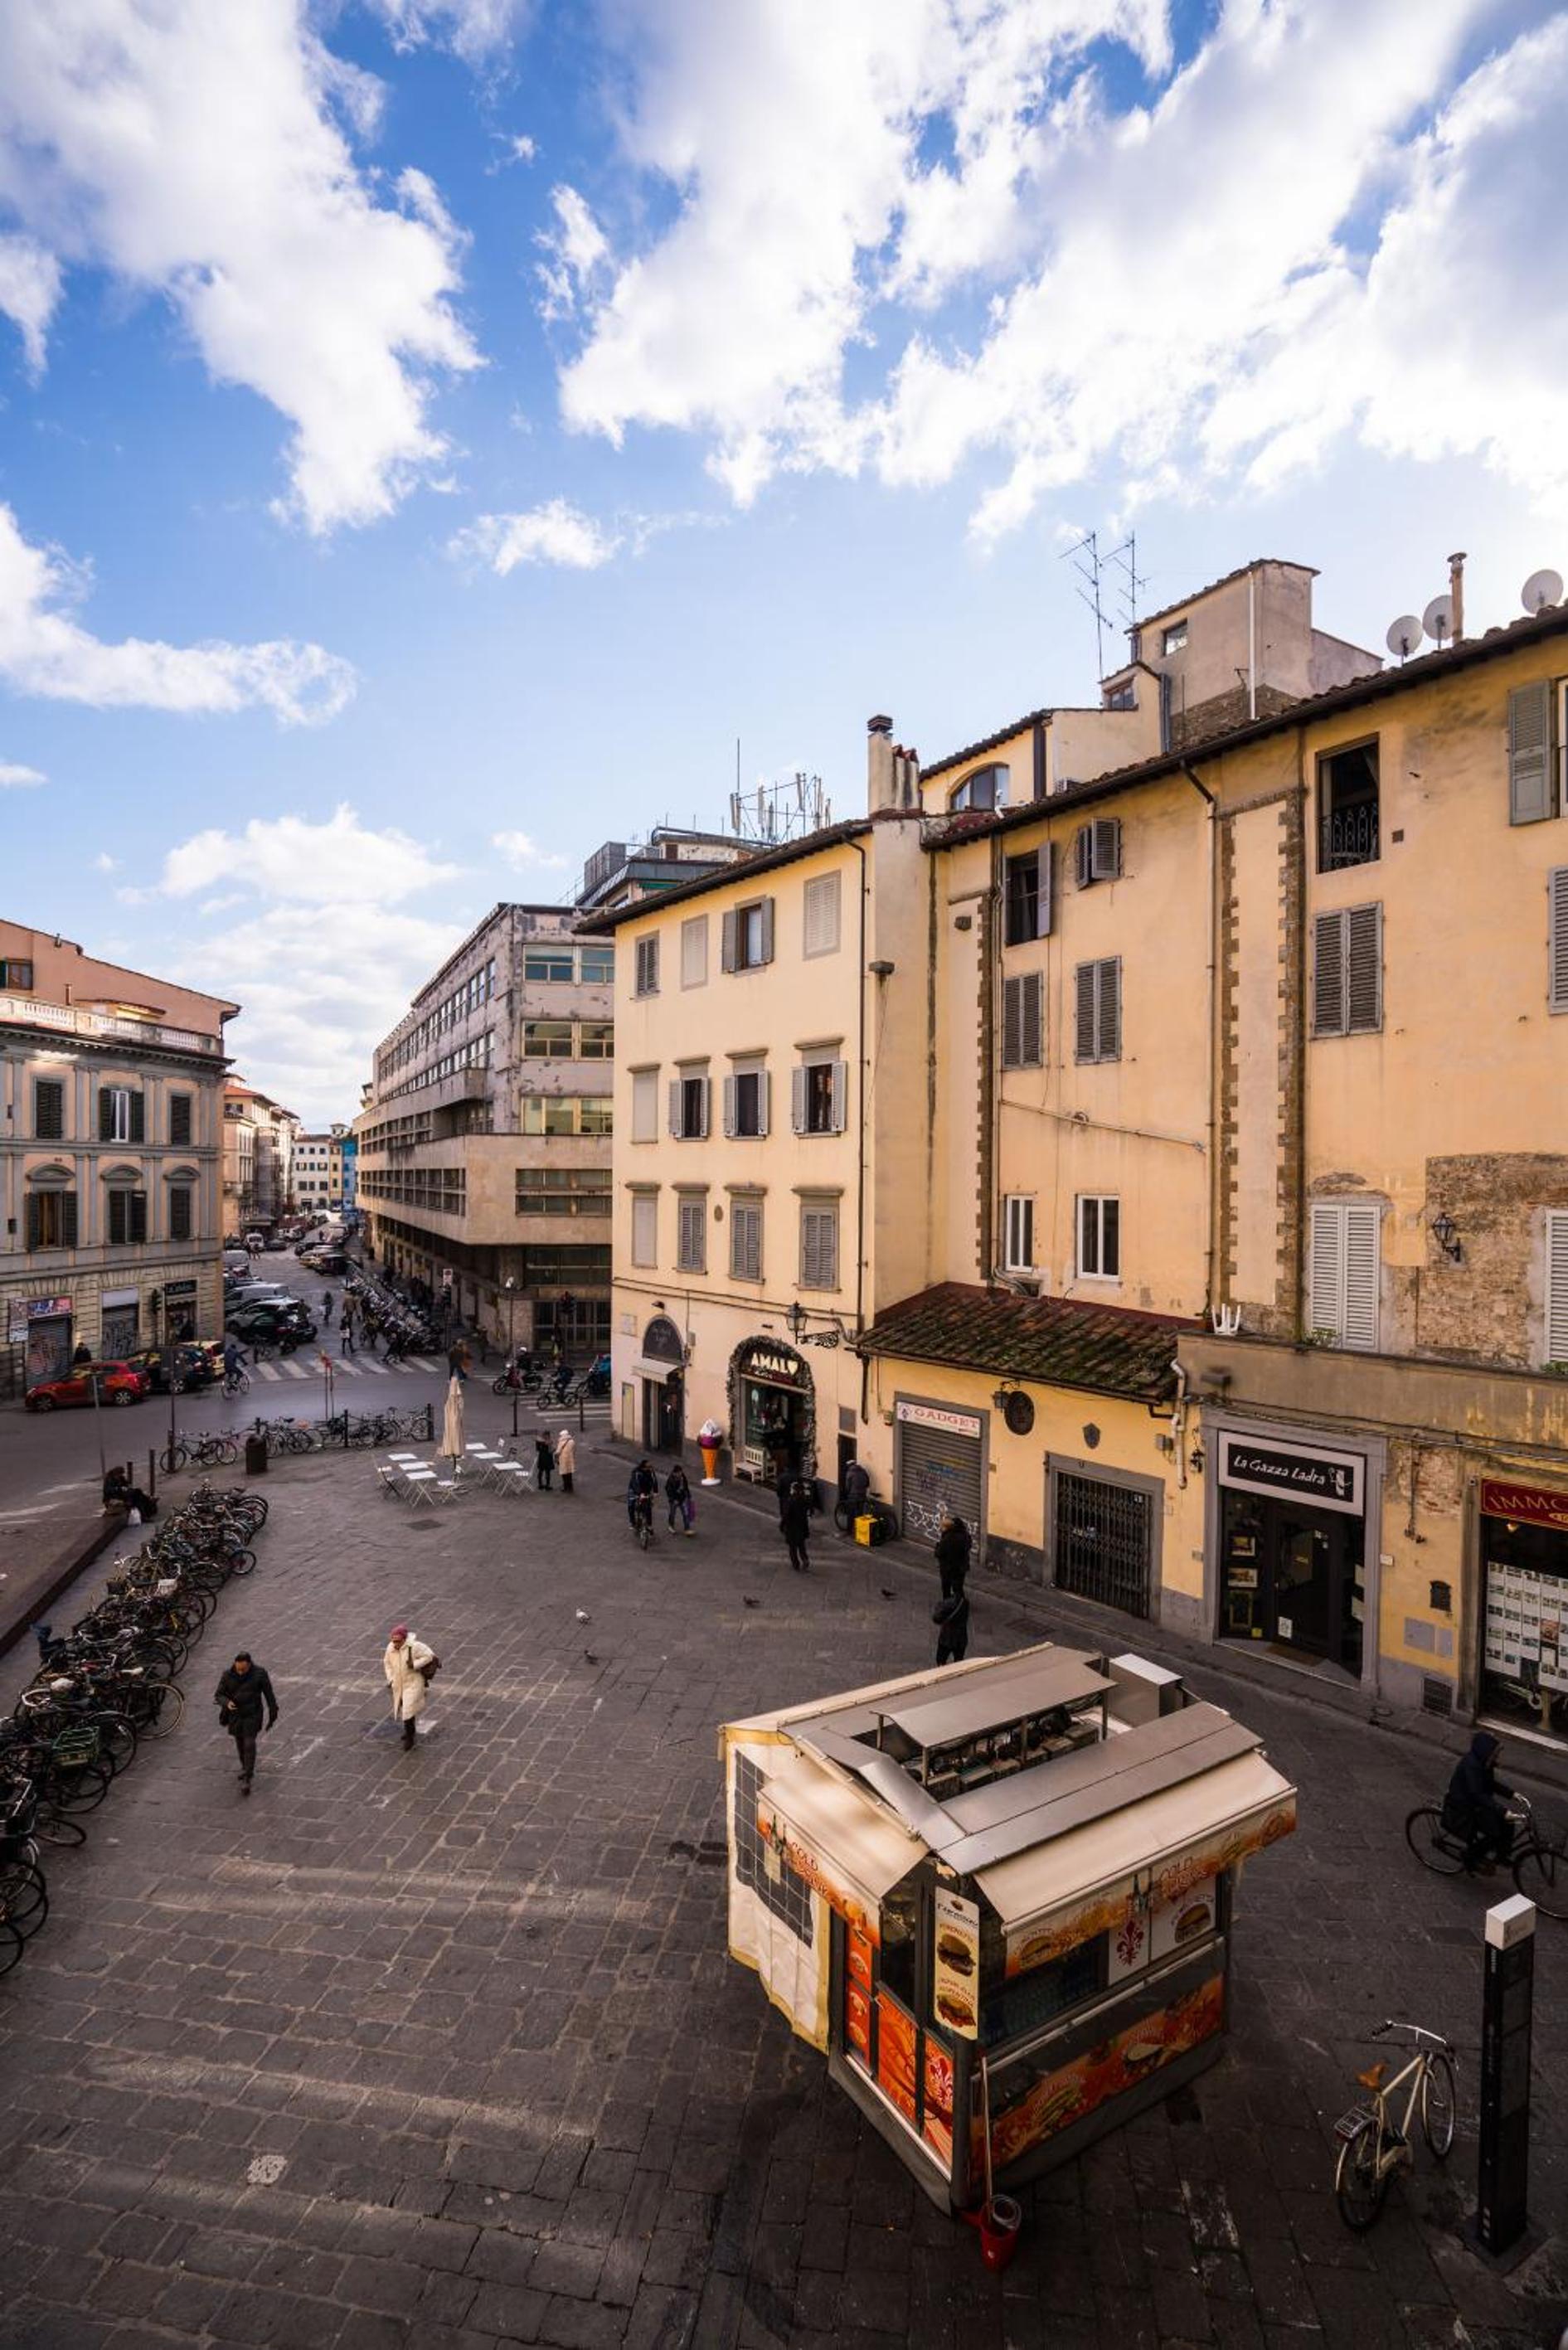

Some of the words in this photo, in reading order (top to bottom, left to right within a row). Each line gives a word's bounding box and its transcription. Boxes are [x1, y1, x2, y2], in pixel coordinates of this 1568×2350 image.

[914, 1408, 978, 1428] GADGET
[1233, 1454, 1247, 1468] La
[1249, 1459, 1289, 1477] Gazza
[1291, 1467, 1326, 1485] Ladra
